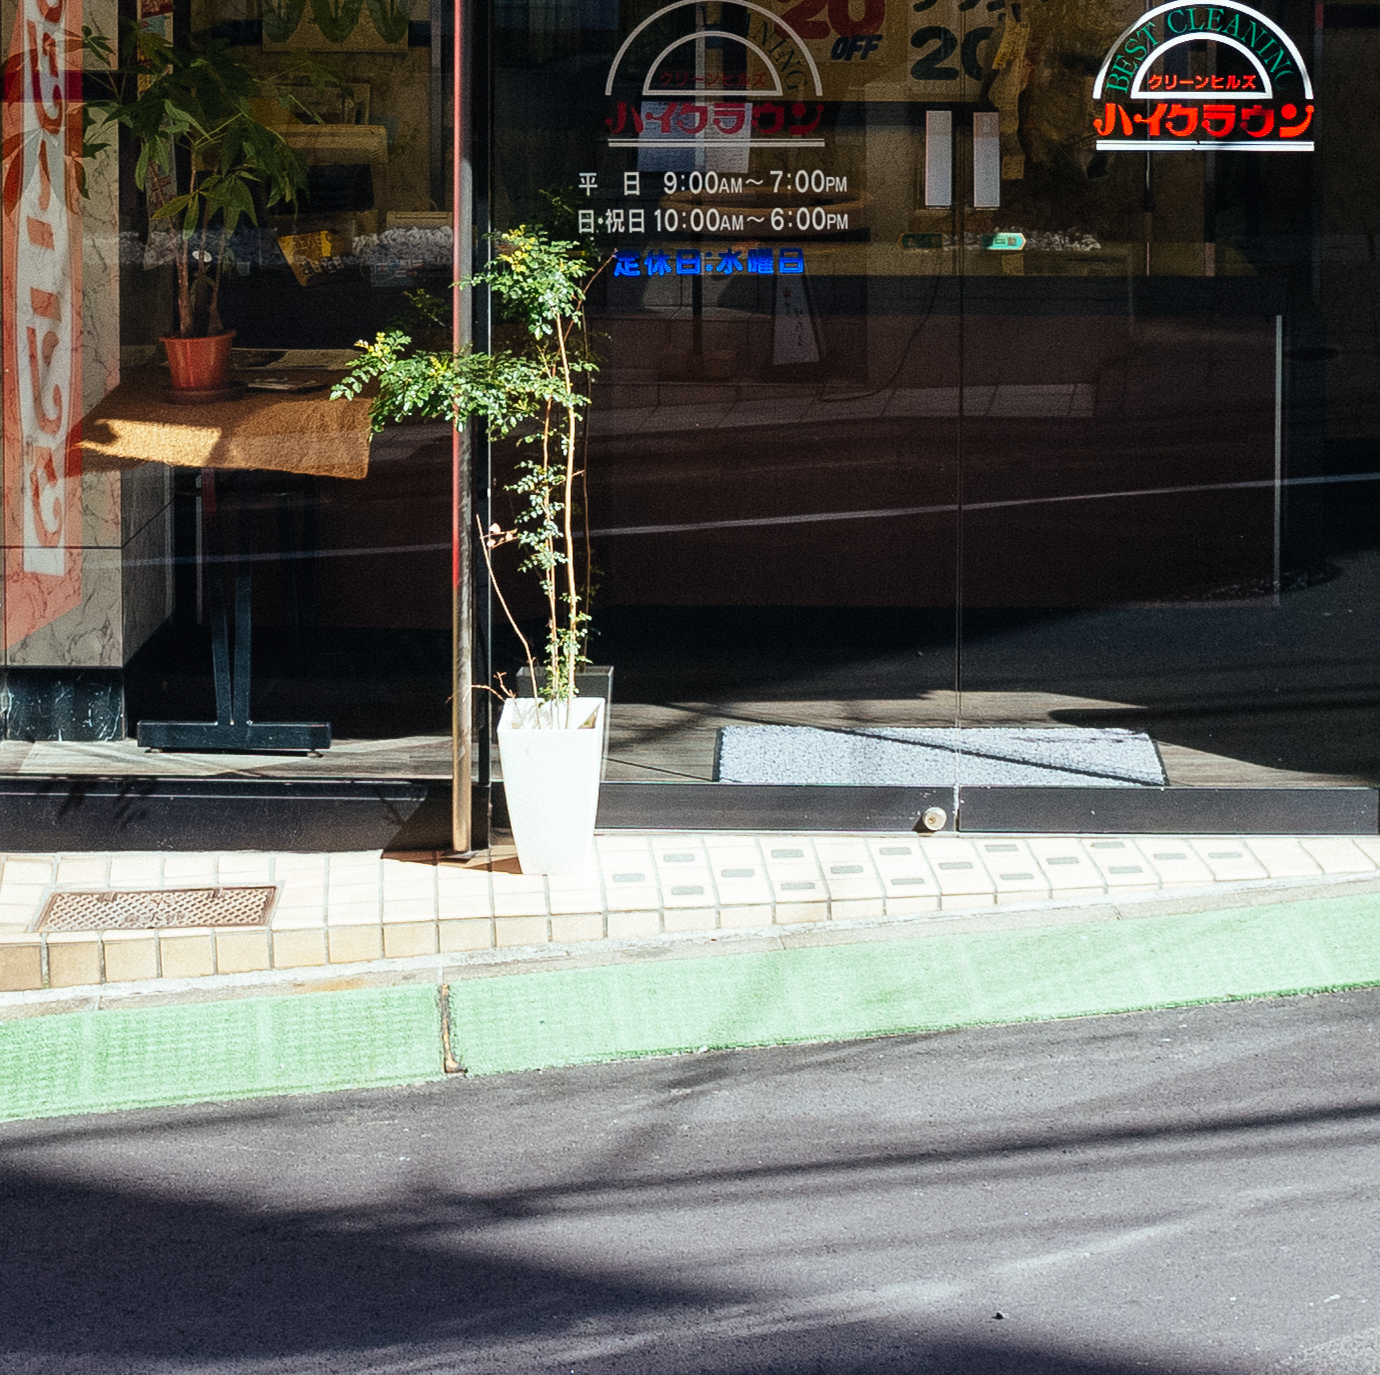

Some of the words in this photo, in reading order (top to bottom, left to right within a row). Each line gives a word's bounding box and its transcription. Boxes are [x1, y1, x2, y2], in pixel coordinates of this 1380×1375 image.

[831, 33, 884, 62] OFF
[1105, 22, 1160, 93] BEST
[1167, 7, 1297, 92] CLEANING
[1148, 74, 1257, 90] クリーンヒルズ
[605, 101, 825, 135] ハイクラウン
[1093, 102, 1315, 138] ハイクラウン
